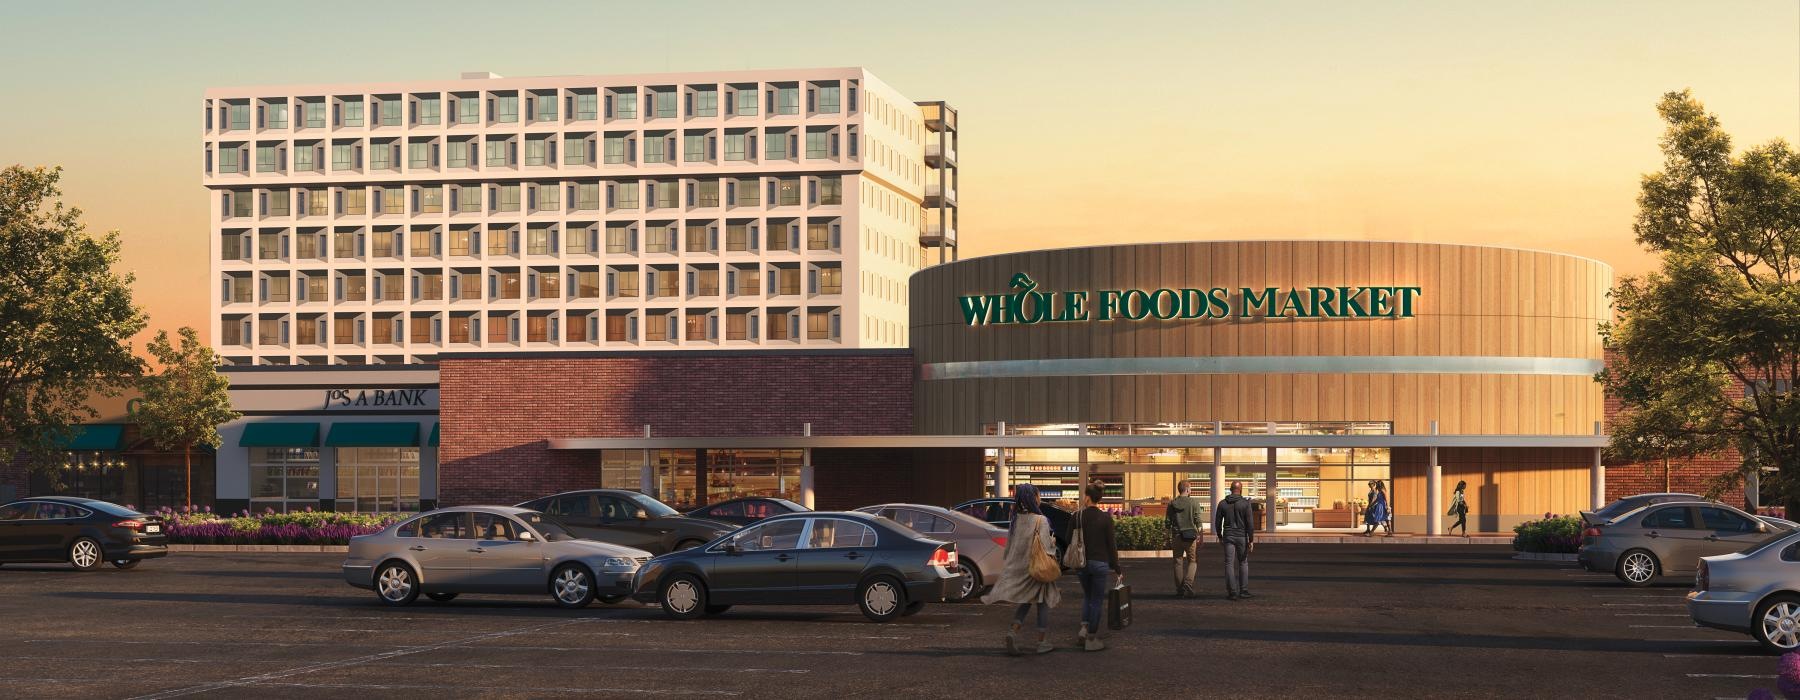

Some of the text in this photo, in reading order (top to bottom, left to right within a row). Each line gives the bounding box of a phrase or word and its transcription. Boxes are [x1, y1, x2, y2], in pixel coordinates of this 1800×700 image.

[958, 272, 1422, 326] WHOLE FOODS MARKET
[354, 389, 369, 406] A
[373, 389, 427, 406] BANK
